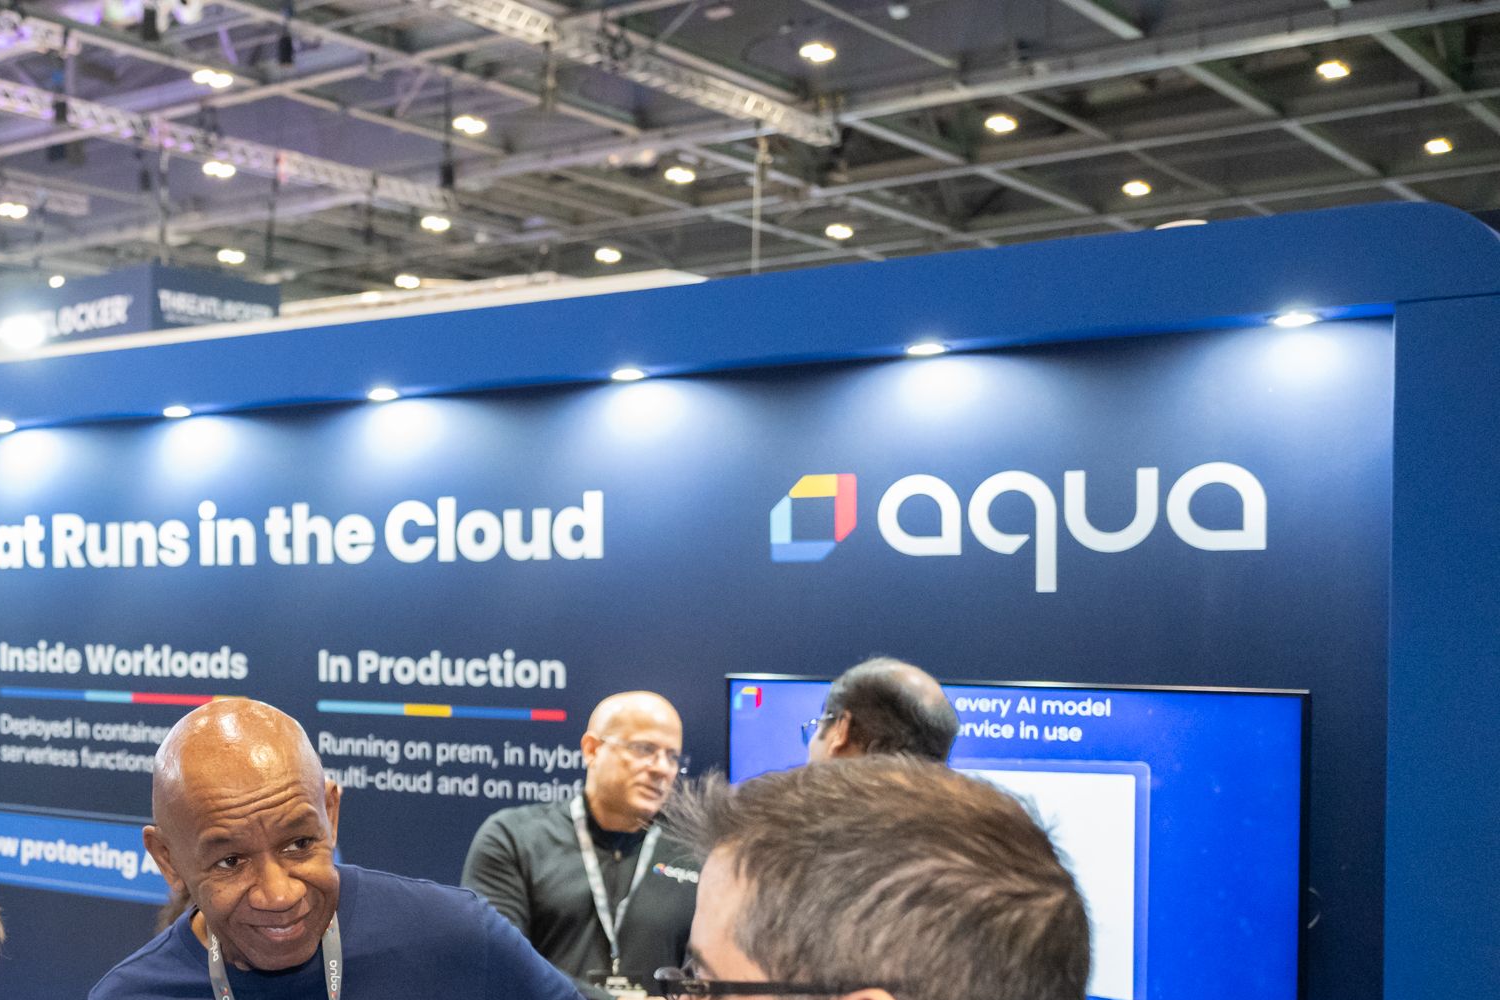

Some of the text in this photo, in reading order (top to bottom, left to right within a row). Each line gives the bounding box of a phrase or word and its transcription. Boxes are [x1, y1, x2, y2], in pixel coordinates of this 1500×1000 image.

[52, 512, 190, 568] Runs
[198, 500, 257, 567] in
[264, 502, 375, 565] the
[385, 490, 604, 562] Cloud
[877, 462, 1268, 592] aqua
[0, 640, 248, 680] Inside Workloads
[318, 649, 567, 689] In Production
[955, 696, 1111, 718] every AI model
[0, 713, 72, 740] Deployed
[74, 718, 90, 738] in
[1019, 720, 1038, 740] in
[1043, 724, 1083, 742] use
[0, 745, 78, 767] serverless
[318, 731, 400, 764] Running
[404, 741, 431, 761] on
[437, 742, 499, 767] prem,
[503, 741, 522, 766] in
[437, 771, 479, 797] and
[483, 779, 515, 799] on
[21, 839, 138, 879] protecting
[329, 959, 340, 992] aqua
